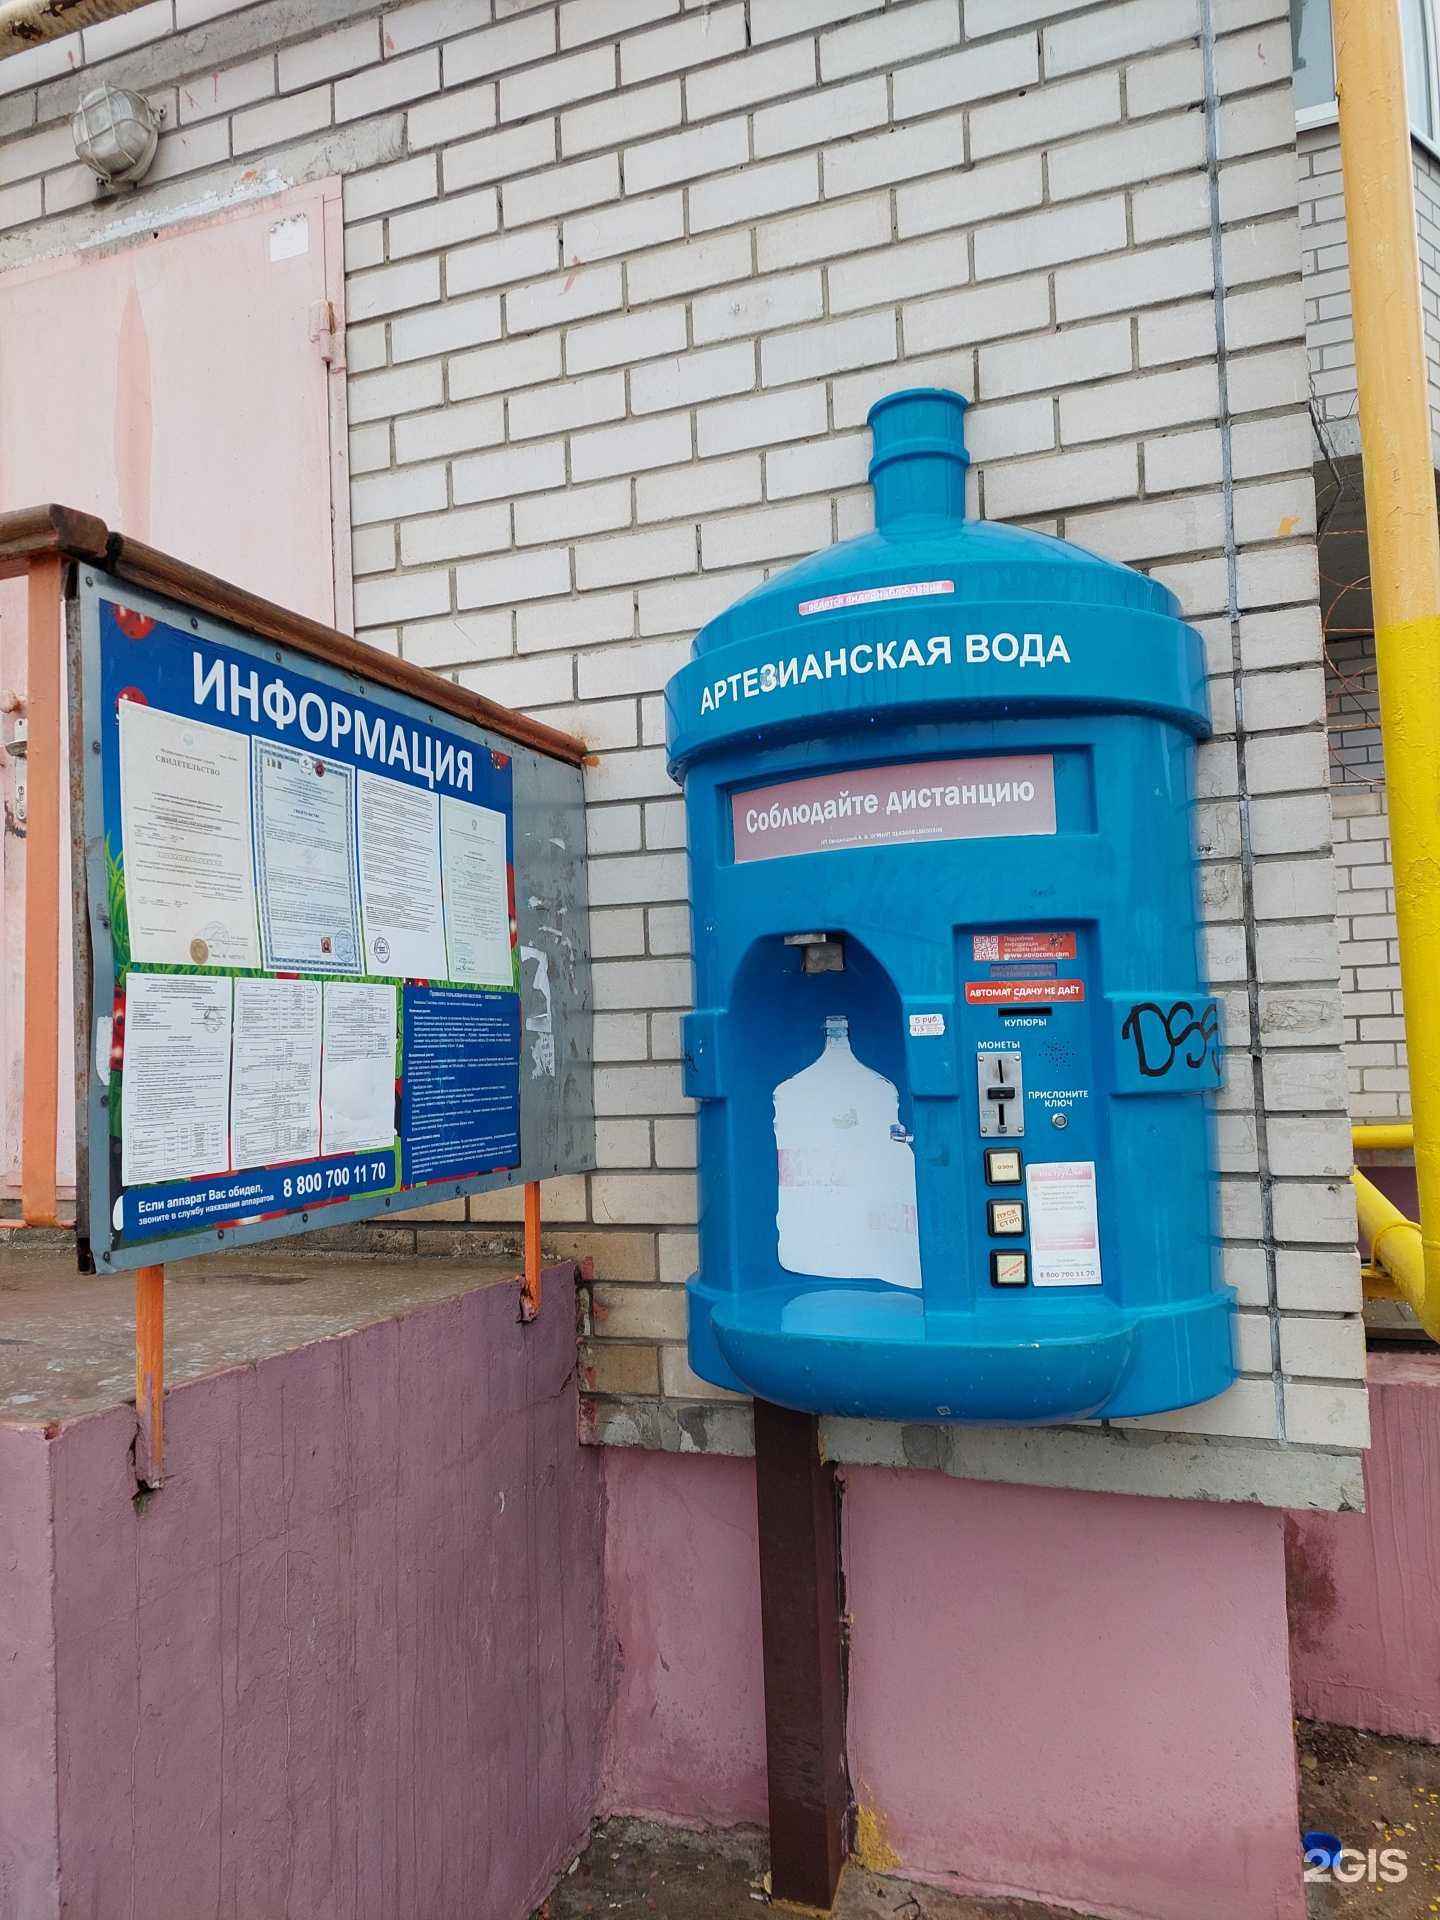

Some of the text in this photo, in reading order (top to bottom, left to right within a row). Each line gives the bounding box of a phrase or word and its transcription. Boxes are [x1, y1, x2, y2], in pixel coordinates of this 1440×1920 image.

[700, 633, 1071, 715] АРТЕЗИАНСКАЯ ВОДА
[193, 652, 473, 791] ИНФОРМАЦИЯ
[746, 781, 1035, 833] Соблюдайте дистанцию
[969, 984, 1080, 998] АВТОМАТ СДАЧУ НЕ ДАЁТ
[1004, 1018, 1047, 1027] КУПЮРЫ
[977, 1041, 1020, 1049] МОНЕТЫ
[1028, 1090, 1089, 1100] ПРИСЛОНИТЕ
[1045, 1100, 1073, 1108] КЛЮЧ
[283, 1161, 386, 1198] 8 800 700 11 70
[138, 1183, 263, 1213] Если аппарат Вас обидел,
[138, 1213, 170, 1226] звоните
[177, 1207, 204, 1220] службу
[205, 1200, 240, 1214] наказания
